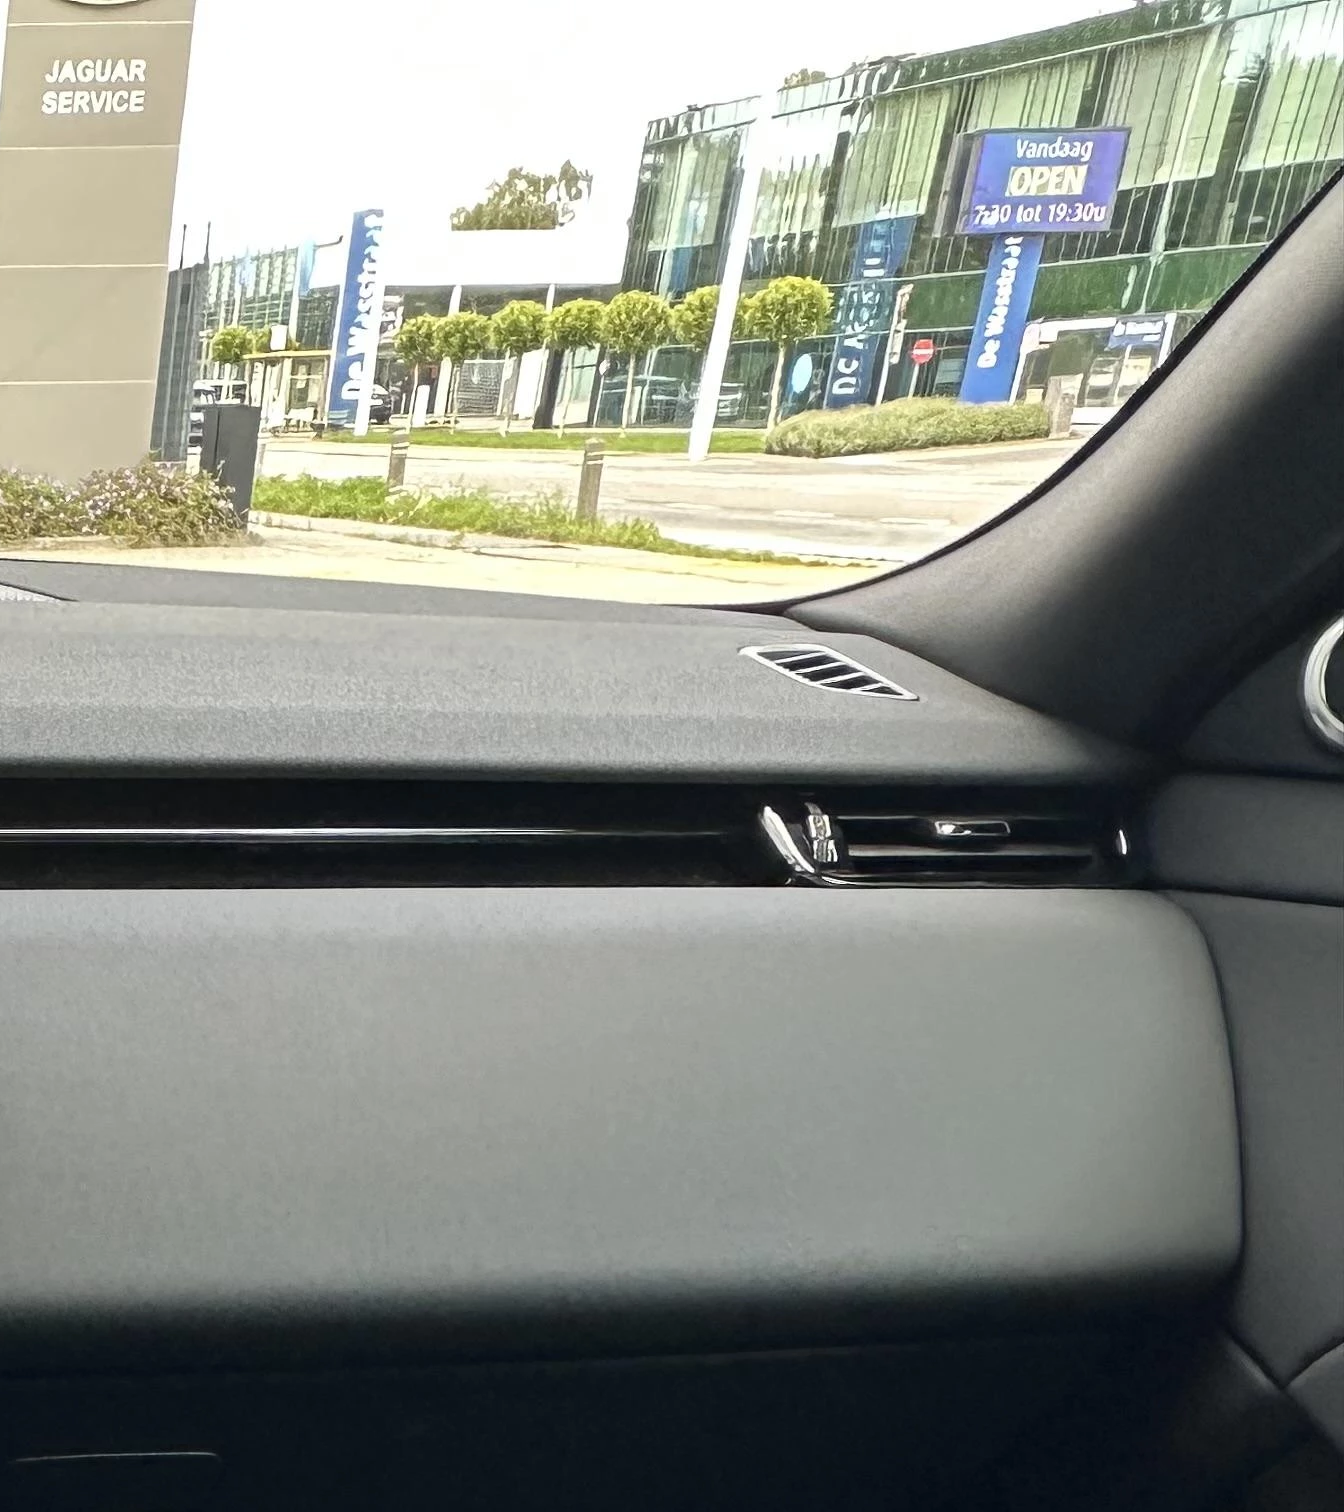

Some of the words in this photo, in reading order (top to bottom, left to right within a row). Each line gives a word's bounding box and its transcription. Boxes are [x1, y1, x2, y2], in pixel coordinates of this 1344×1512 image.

[44, 58, 147, 83] JAGUAR
[41, 90, 146, 114] SERVICE
[1016, 136, 1094, 162] Vandaag
[1011, 166, 1087, 196] OPEN
[1048, 202, 1108, 223] 19:30u
